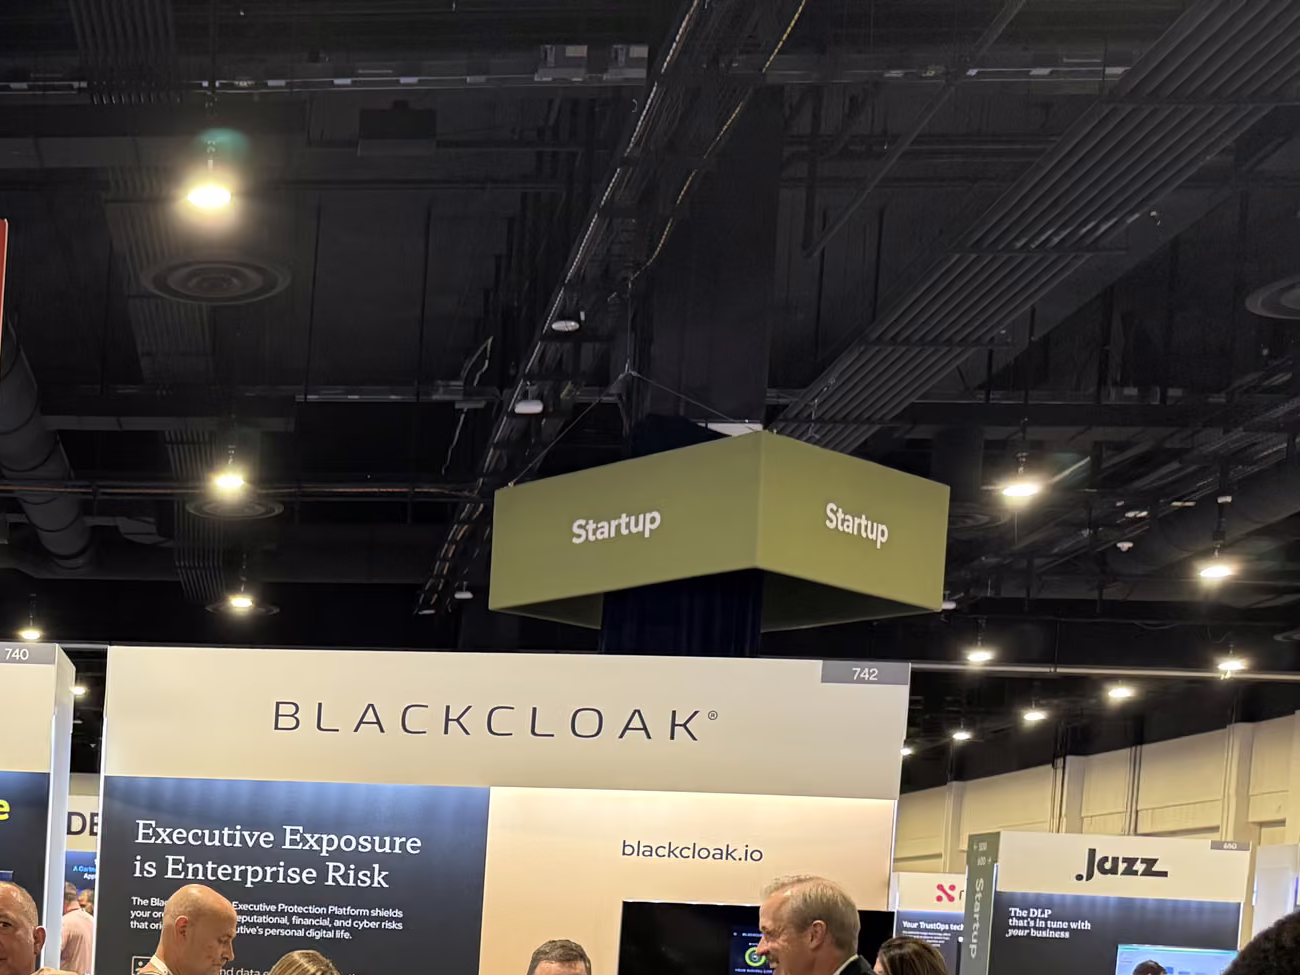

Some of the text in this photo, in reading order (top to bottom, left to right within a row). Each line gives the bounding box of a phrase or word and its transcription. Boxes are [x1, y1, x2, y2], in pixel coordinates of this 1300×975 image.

[572, 511, 661, 544] Startup
[825, 503, 888, 549] Startup
[4, 648, 29, 660] 740
[851, 668, 878, 681] 742
[134, 819, 422, 856] Executive Exposure
[621, 839, 764, 862] blackcloak.io
[133, 855, 390, 889] is Enterprise Risk
[131, 897, 149, 906] The
[232, 901, 276, 912] Executive
[278, 903, 327, 914] Protection
[328, 905, 369, 916] Platform
[370, 907, 403, 918] shields
[1009, 907, 1052, 918] The DLP
[130, 910, 151, 919] your
[237, 914, 289, 926] eputational,
[292, 916, 332, 927] financial,
[333, 918, 351, 927] and
[353, 918, 379, 930] cyber
[382, 920, 403, 929] risks
[903, 920, 918, 929] Your
[919, 921, 949, 931] TrustOps
[969, 878, 984, 959] Startup
[1009, 917, 1091, 930] that's in tune with
[130, 920, 148, 930] that
[264, 927, 304, 938] personal
[306, 928, 333, 939] digital
[335, 929, 352, 939] life.
[1005, 928, 1070, 939] your business
